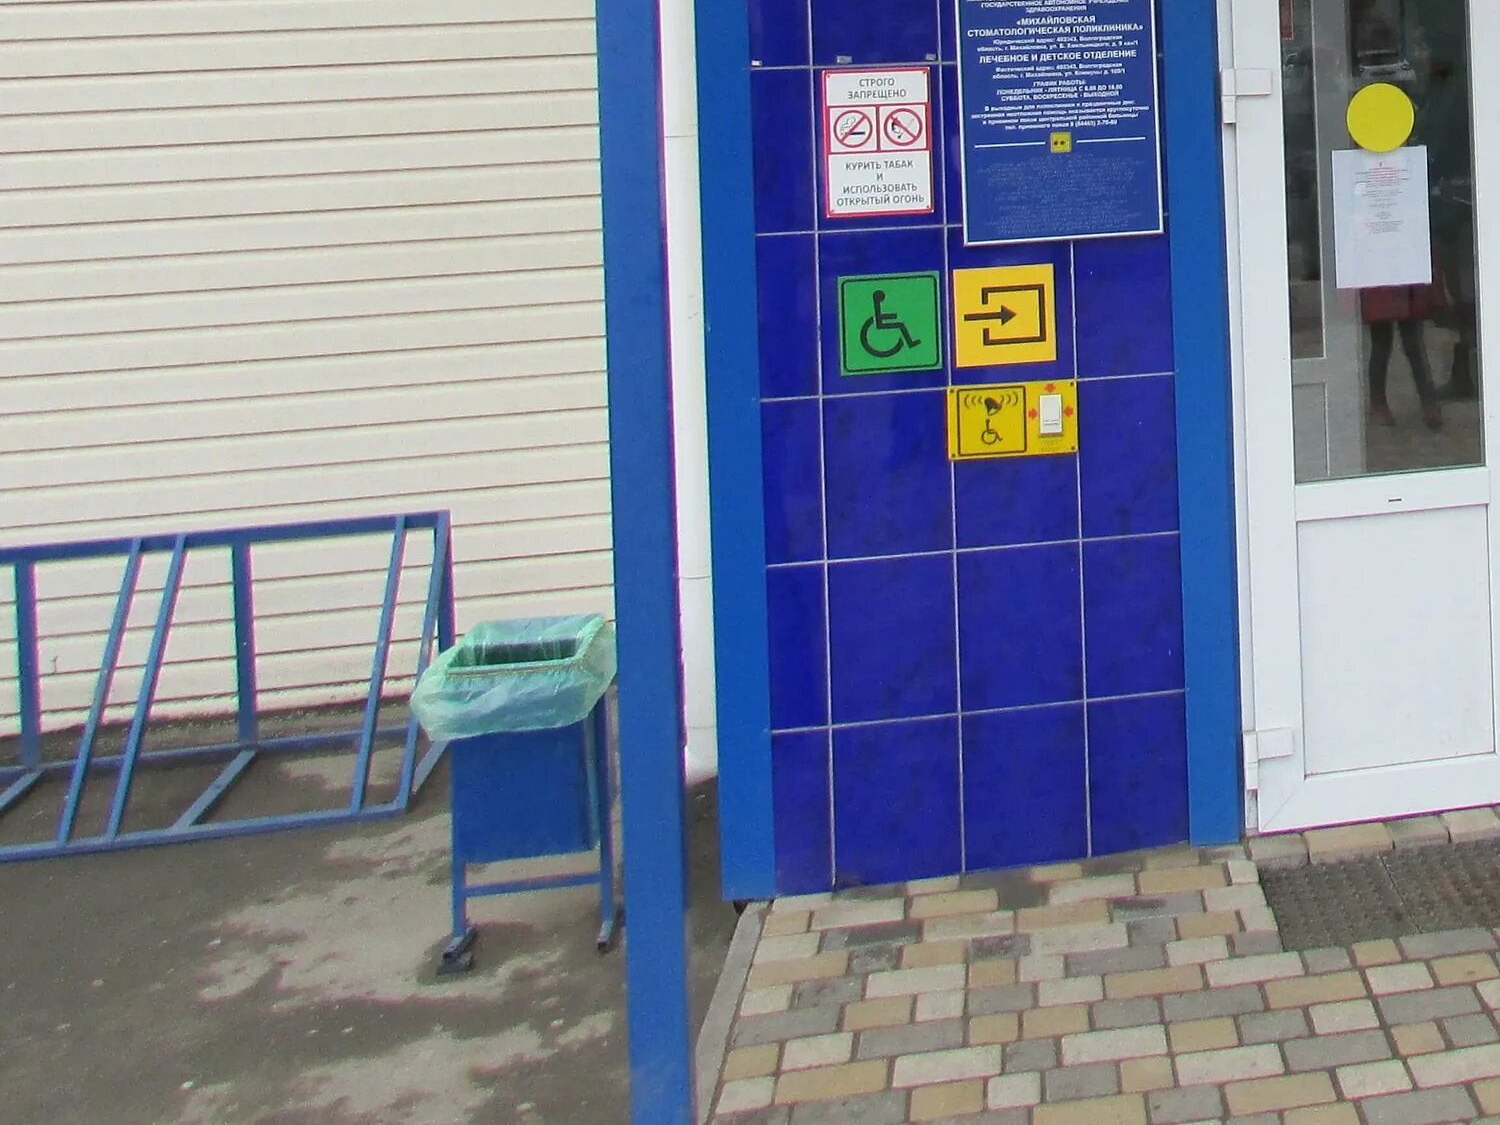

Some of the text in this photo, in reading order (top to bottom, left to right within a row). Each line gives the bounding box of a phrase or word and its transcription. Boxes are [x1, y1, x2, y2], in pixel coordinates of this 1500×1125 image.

[1016, 15, 1096, 26] «МИХАЙЛОВСКАЯ
[967, 23, 1143, 37] СТОМАТОЛОГИЧЕСКАЯ ПОЛИКЛИНИКА»
[979, 54, 1029, 64] ЛЕЧЕБНОЕ
[1039, 52, 1082, 62] ДЕТСКОЕ
[1083, 50, 1137, 59] ОТДЕЛЕНИЕ
[859, 77, 895, 88] СТРОГО
[848, 89, 907, 100] ЗАПРЕЩЕНО
[845, 160, 914, 172] КУРИТЬ ТАБАК
[877, 173, 884, 181] И
[842, 183, 918, 194] ИСПОЛЬЗОВАТЬ
[836, 193, 925, 207] ОТКРЫТЫЙ ОГОНЬ
